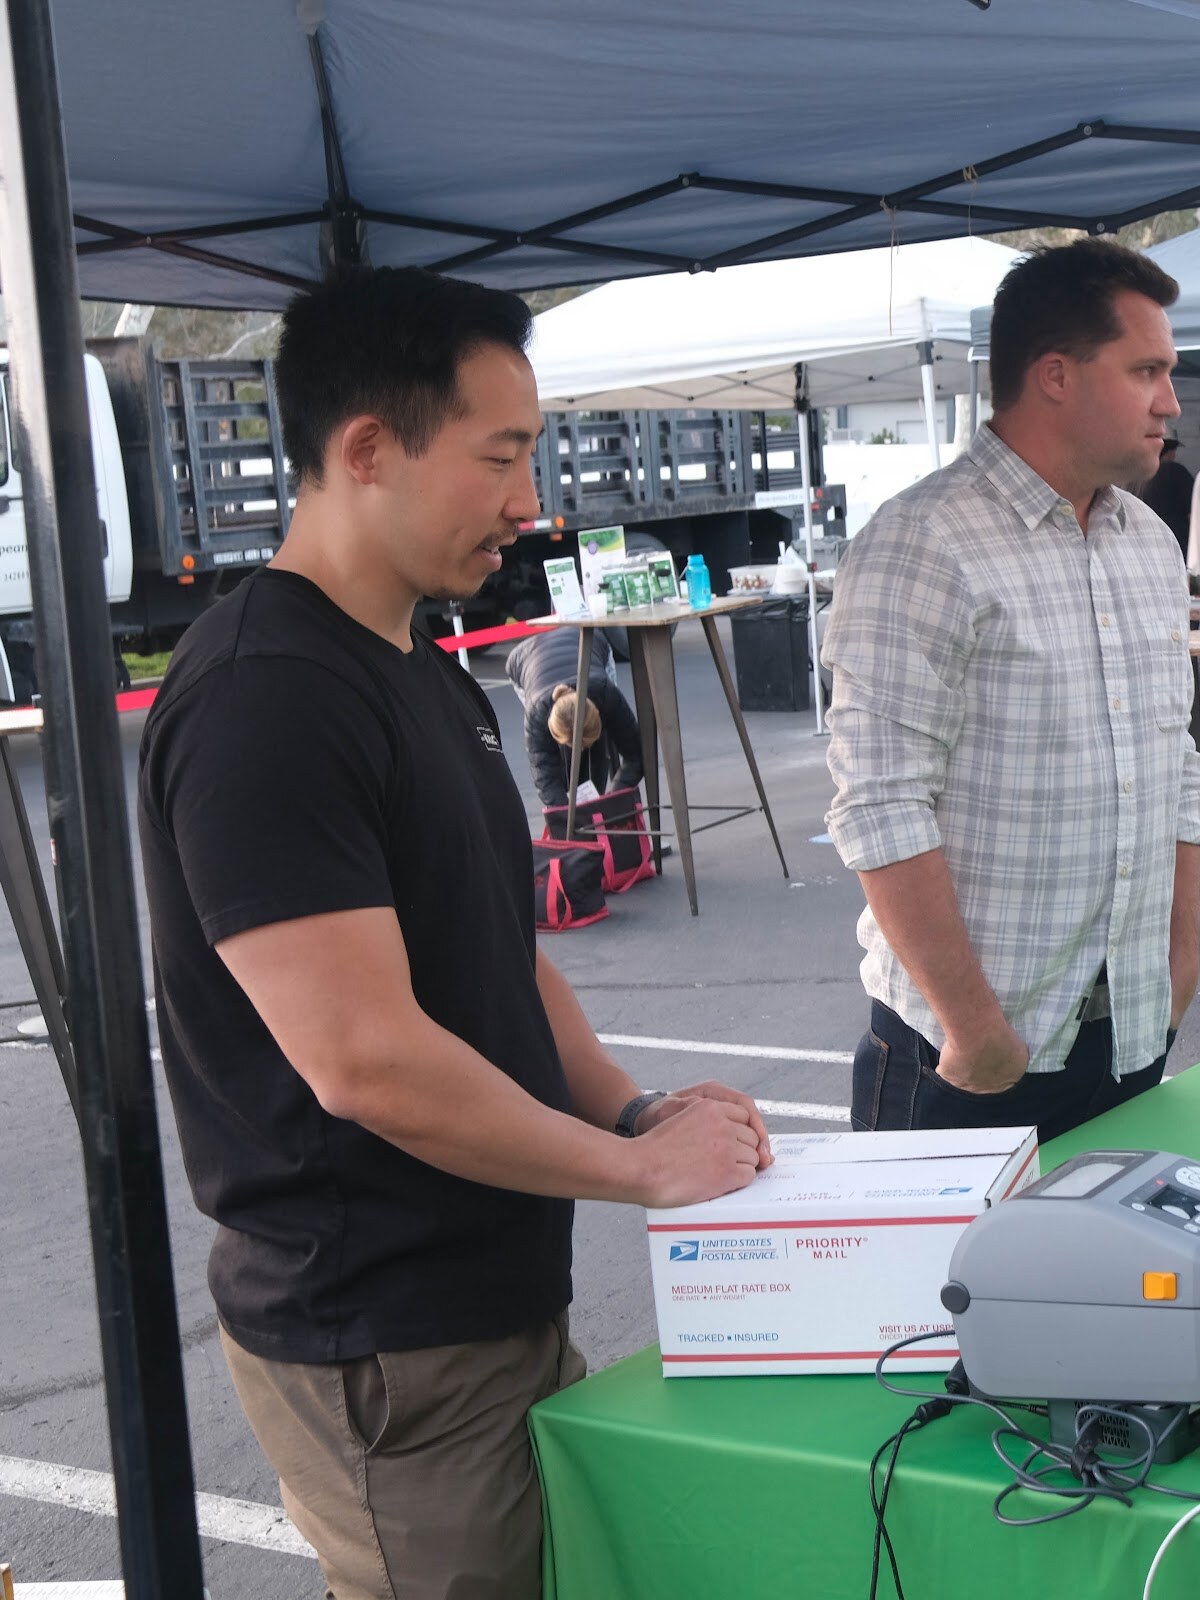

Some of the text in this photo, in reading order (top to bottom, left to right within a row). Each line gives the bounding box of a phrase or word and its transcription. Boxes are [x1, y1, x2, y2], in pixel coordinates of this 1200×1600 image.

[702, 1238, 772, 1247] UNITED STATES
[701, 1252, 736, 1261] POSTAL
[813, 1250, 848, 1259] MAIL
[671, 1283, 792, 1295] MEDIUM FLAT RATE BOX
[879, 1324, 901, 1333] VISIT
[904, 1324, 917, 1332] US
[919, 1324, 930, 1332] AT
[677, 1333, 779, 1343] TRACKED INSURED
